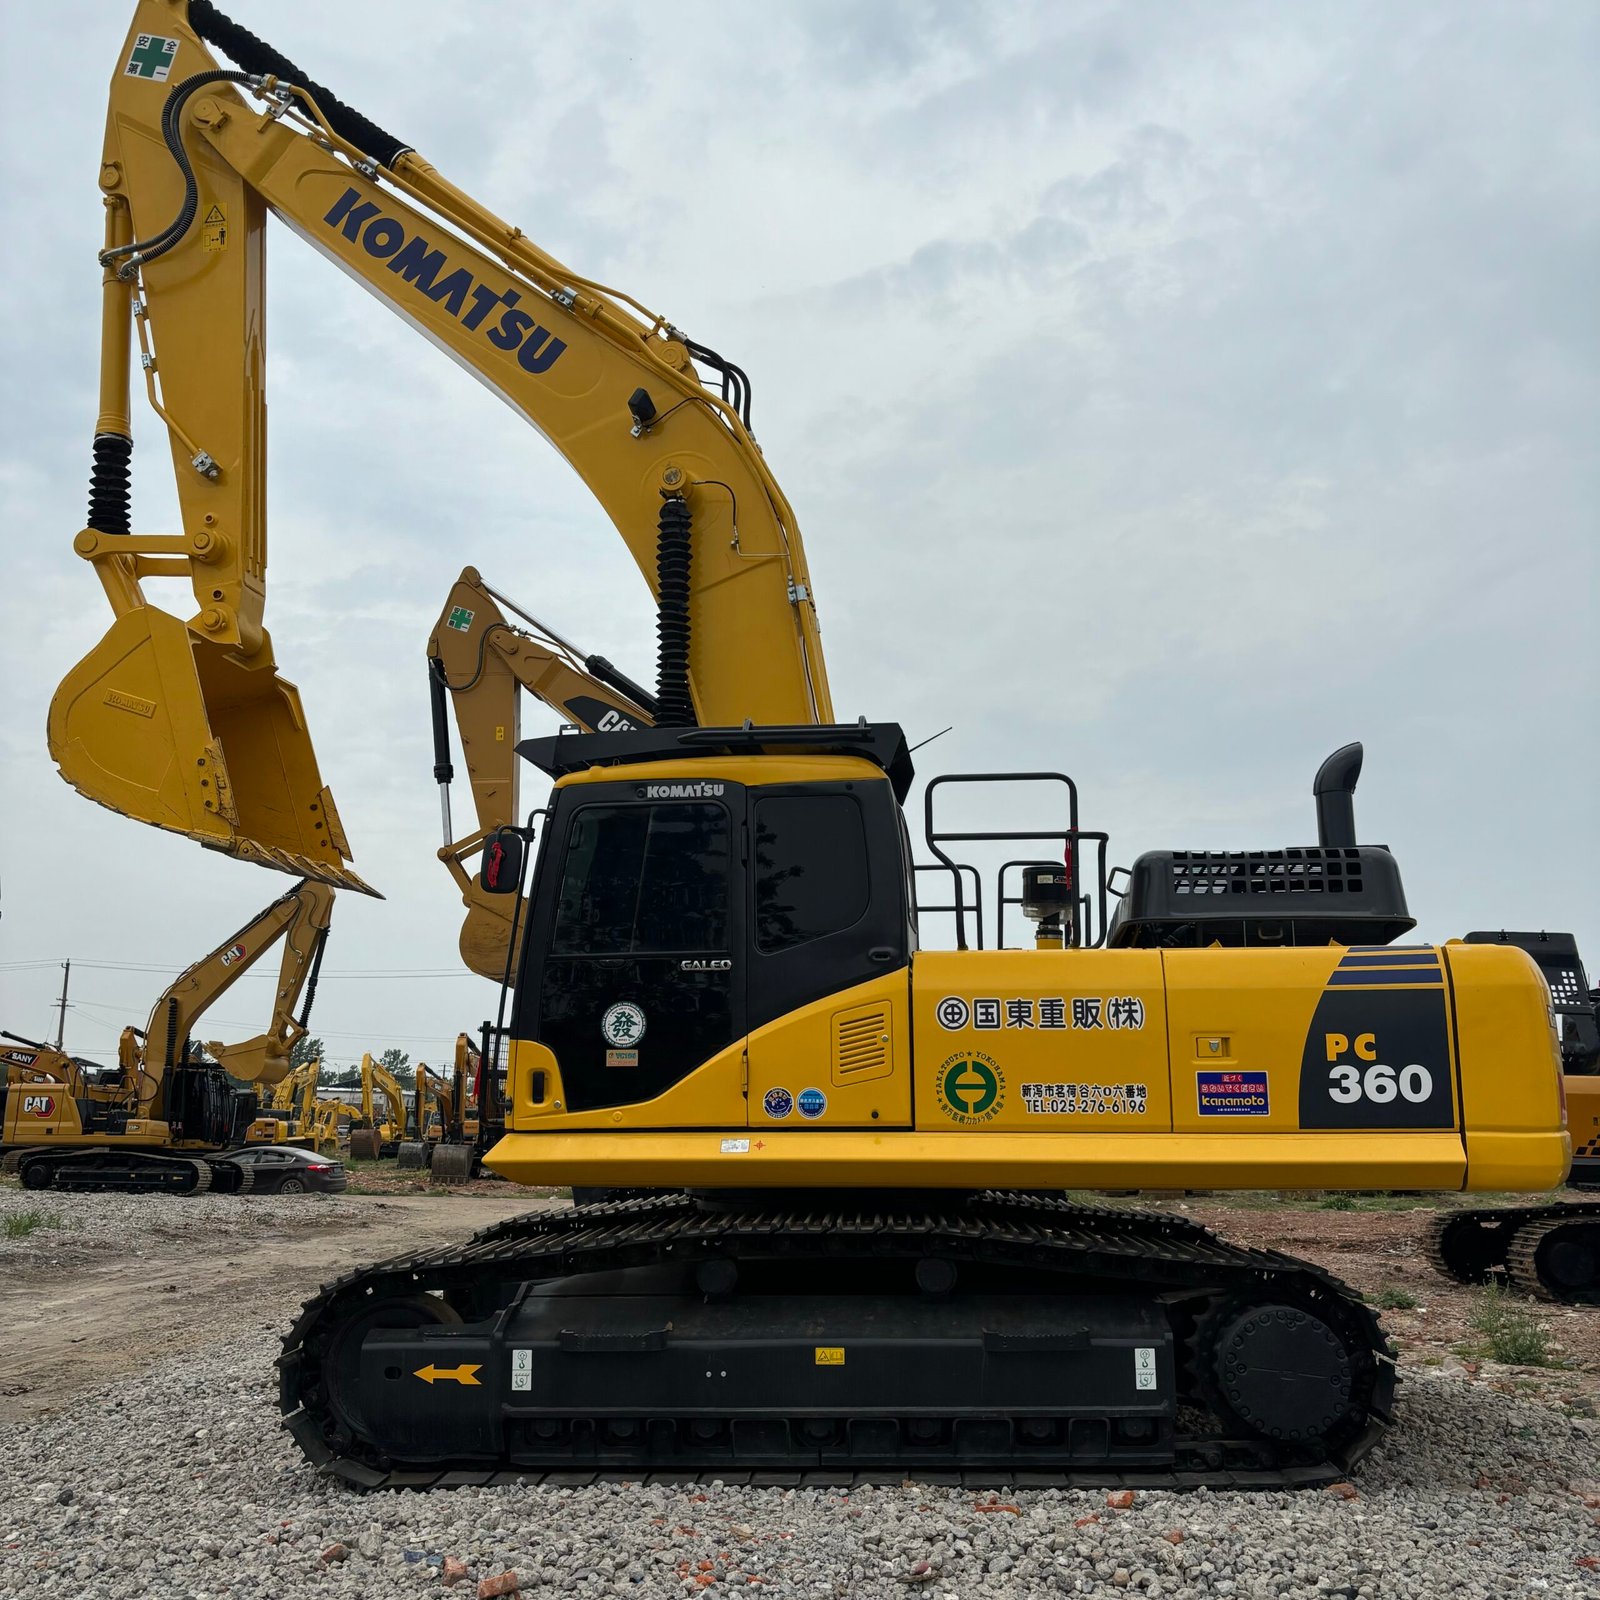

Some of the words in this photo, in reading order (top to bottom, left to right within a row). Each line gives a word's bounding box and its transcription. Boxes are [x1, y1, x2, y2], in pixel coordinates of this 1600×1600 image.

[323, 187, 568, 374] KOMATSU
[108, 693, 151, 713] KOMATSU
[597, 710, 638, 732] CA
[647, 781, 724, 798] KOMATSU
[221, 945, 241, 967] CAT
[680, 960, 732, 971] GALEO
[1325, 1033, 1377, 1061] PC
[11, 1052, 33, 1064] SANY
[1328, 1064, 1433, 1104] 360
[24, 1096, 49, 1112] CAT
[1025, 1100, 1146, 1114] TEL:025-276-6196
[1201, 1095, 1265, 1106] kanamoto
